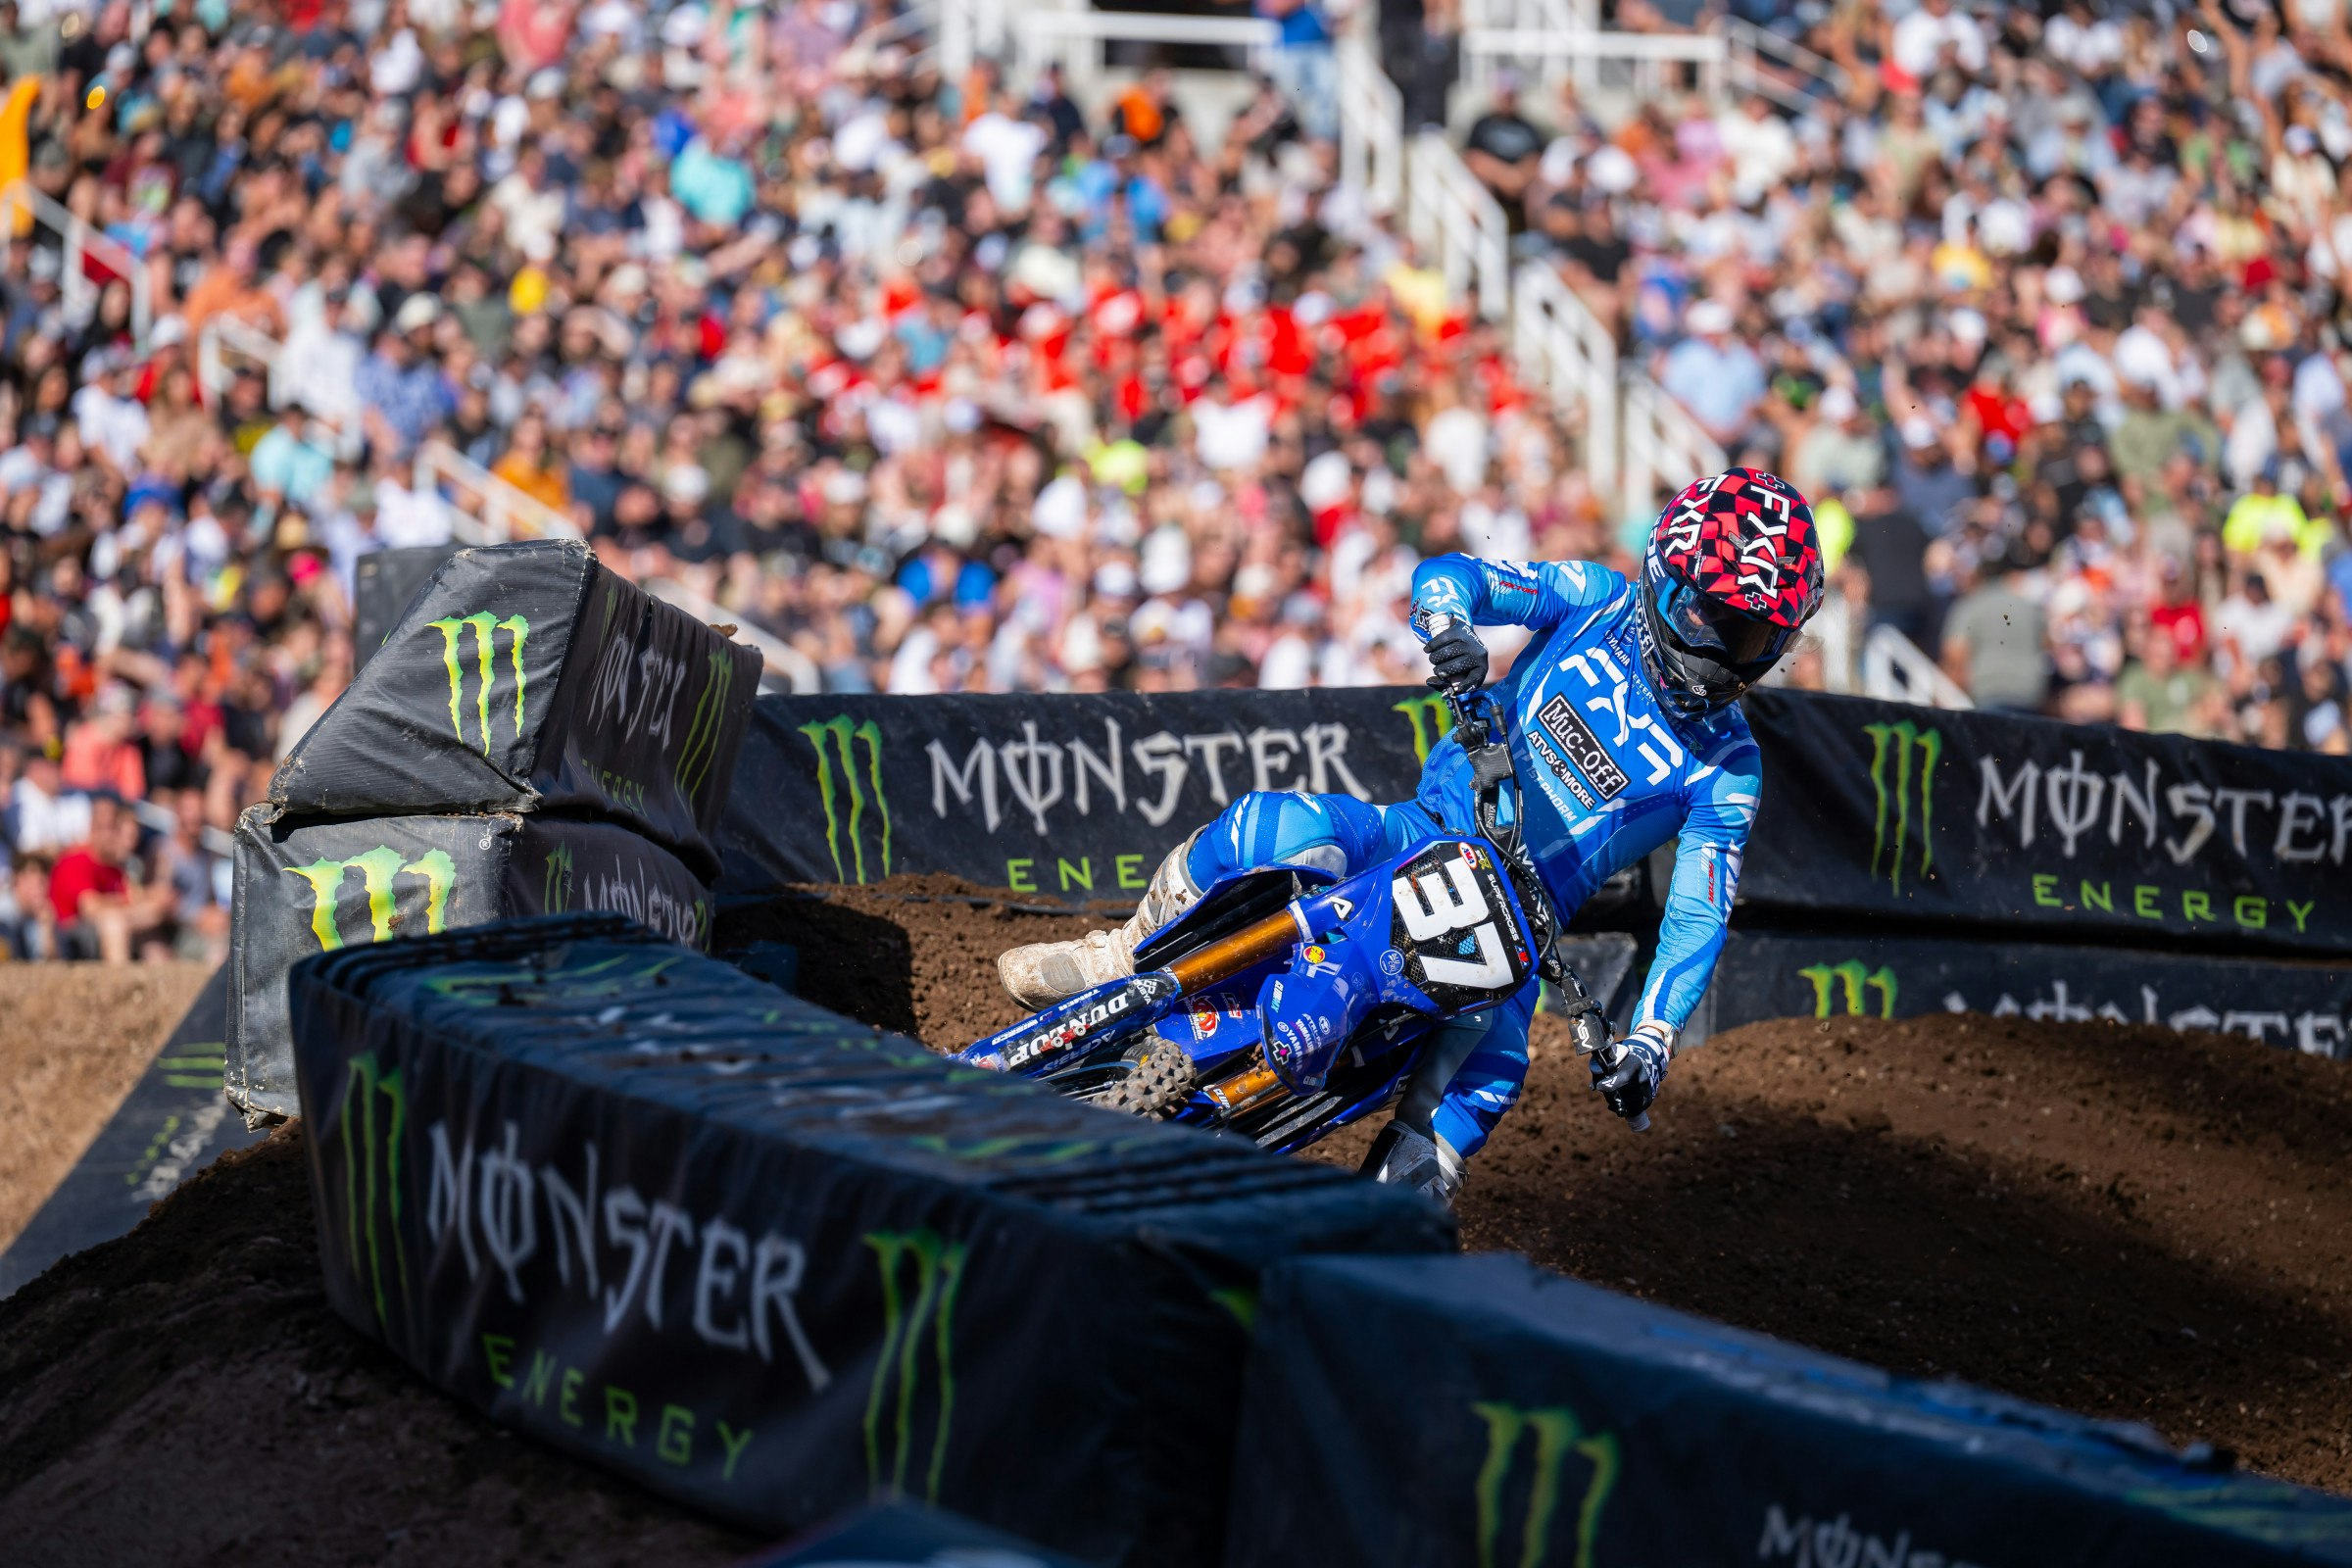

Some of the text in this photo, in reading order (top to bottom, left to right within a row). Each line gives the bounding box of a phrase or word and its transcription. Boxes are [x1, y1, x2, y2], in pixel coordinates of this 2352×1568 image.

[1737, 485, 1790, 600] FXR
[1632, 670, 1657, 703] EFFERY
[924, 715, 1372, 836] MONSTER
[1527, 730, 1596, 810] ATVS&MORE
[1544, 702, 1623, 793] Muc-Off
[1006, 854, 1147, 893] ENE
[1487, 873, 1520, 942] SUPERCROSS
[2033, 873, 2316, 934] ENERGY
[1392, 857, 1514, 990] 37
[1286, 1029, 1303, 1072] YAMAHA
[426, 1119, 831, 1392] MONSTER
[482, 1332, 755, 1481] ENERGY
